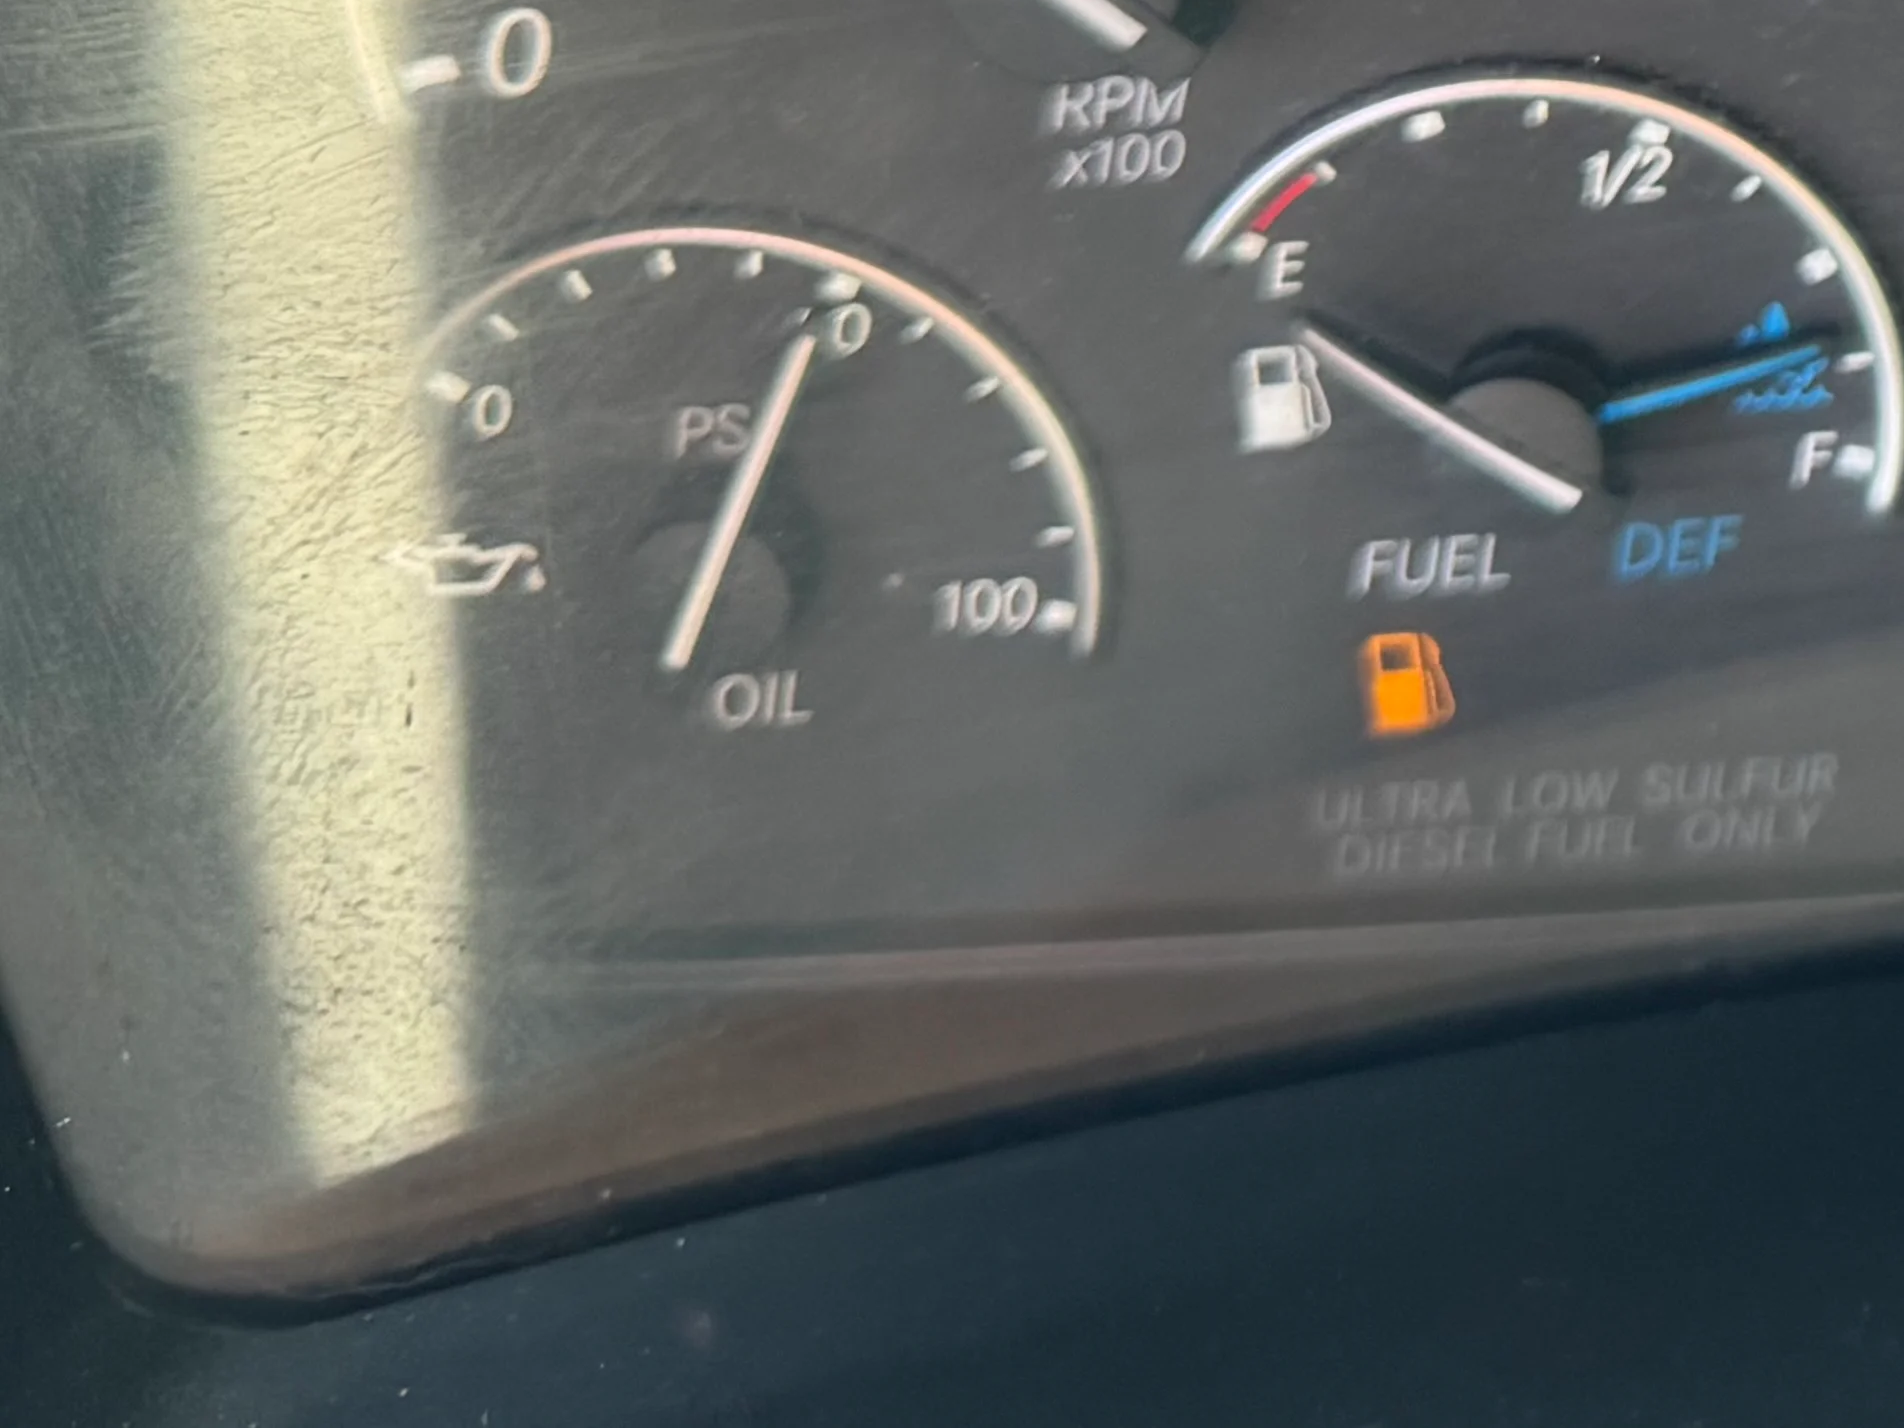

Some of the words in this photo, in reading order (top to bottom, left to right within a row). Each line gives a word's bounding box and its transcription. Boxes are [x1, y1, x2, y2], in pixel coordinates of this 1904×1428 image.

[482, 5, 555, 100] 0
[1580, 146, 1675, 210] 1/2
[1261, 239, 1311, 301] E
[465, 384, 513, 440] 0
[672, 400, 770, 460] PS
[1788, 430, 1839, 490] F
[1348, 532, 1513, 600] FUEL
[1615, 514, 1746, 581] DEF
[933, 576, 1040, 637] 100
[709, 670, 817, 732] OIL
[1311, 777, 1473, 831] ULTRA
[1499, 764, 1621, 817] LOW
[1642, 750, 1842, 808] SULFUR
[1523, 813, 1644, 864] FUEL
[1680, 799, 1826, 856] ONLY
